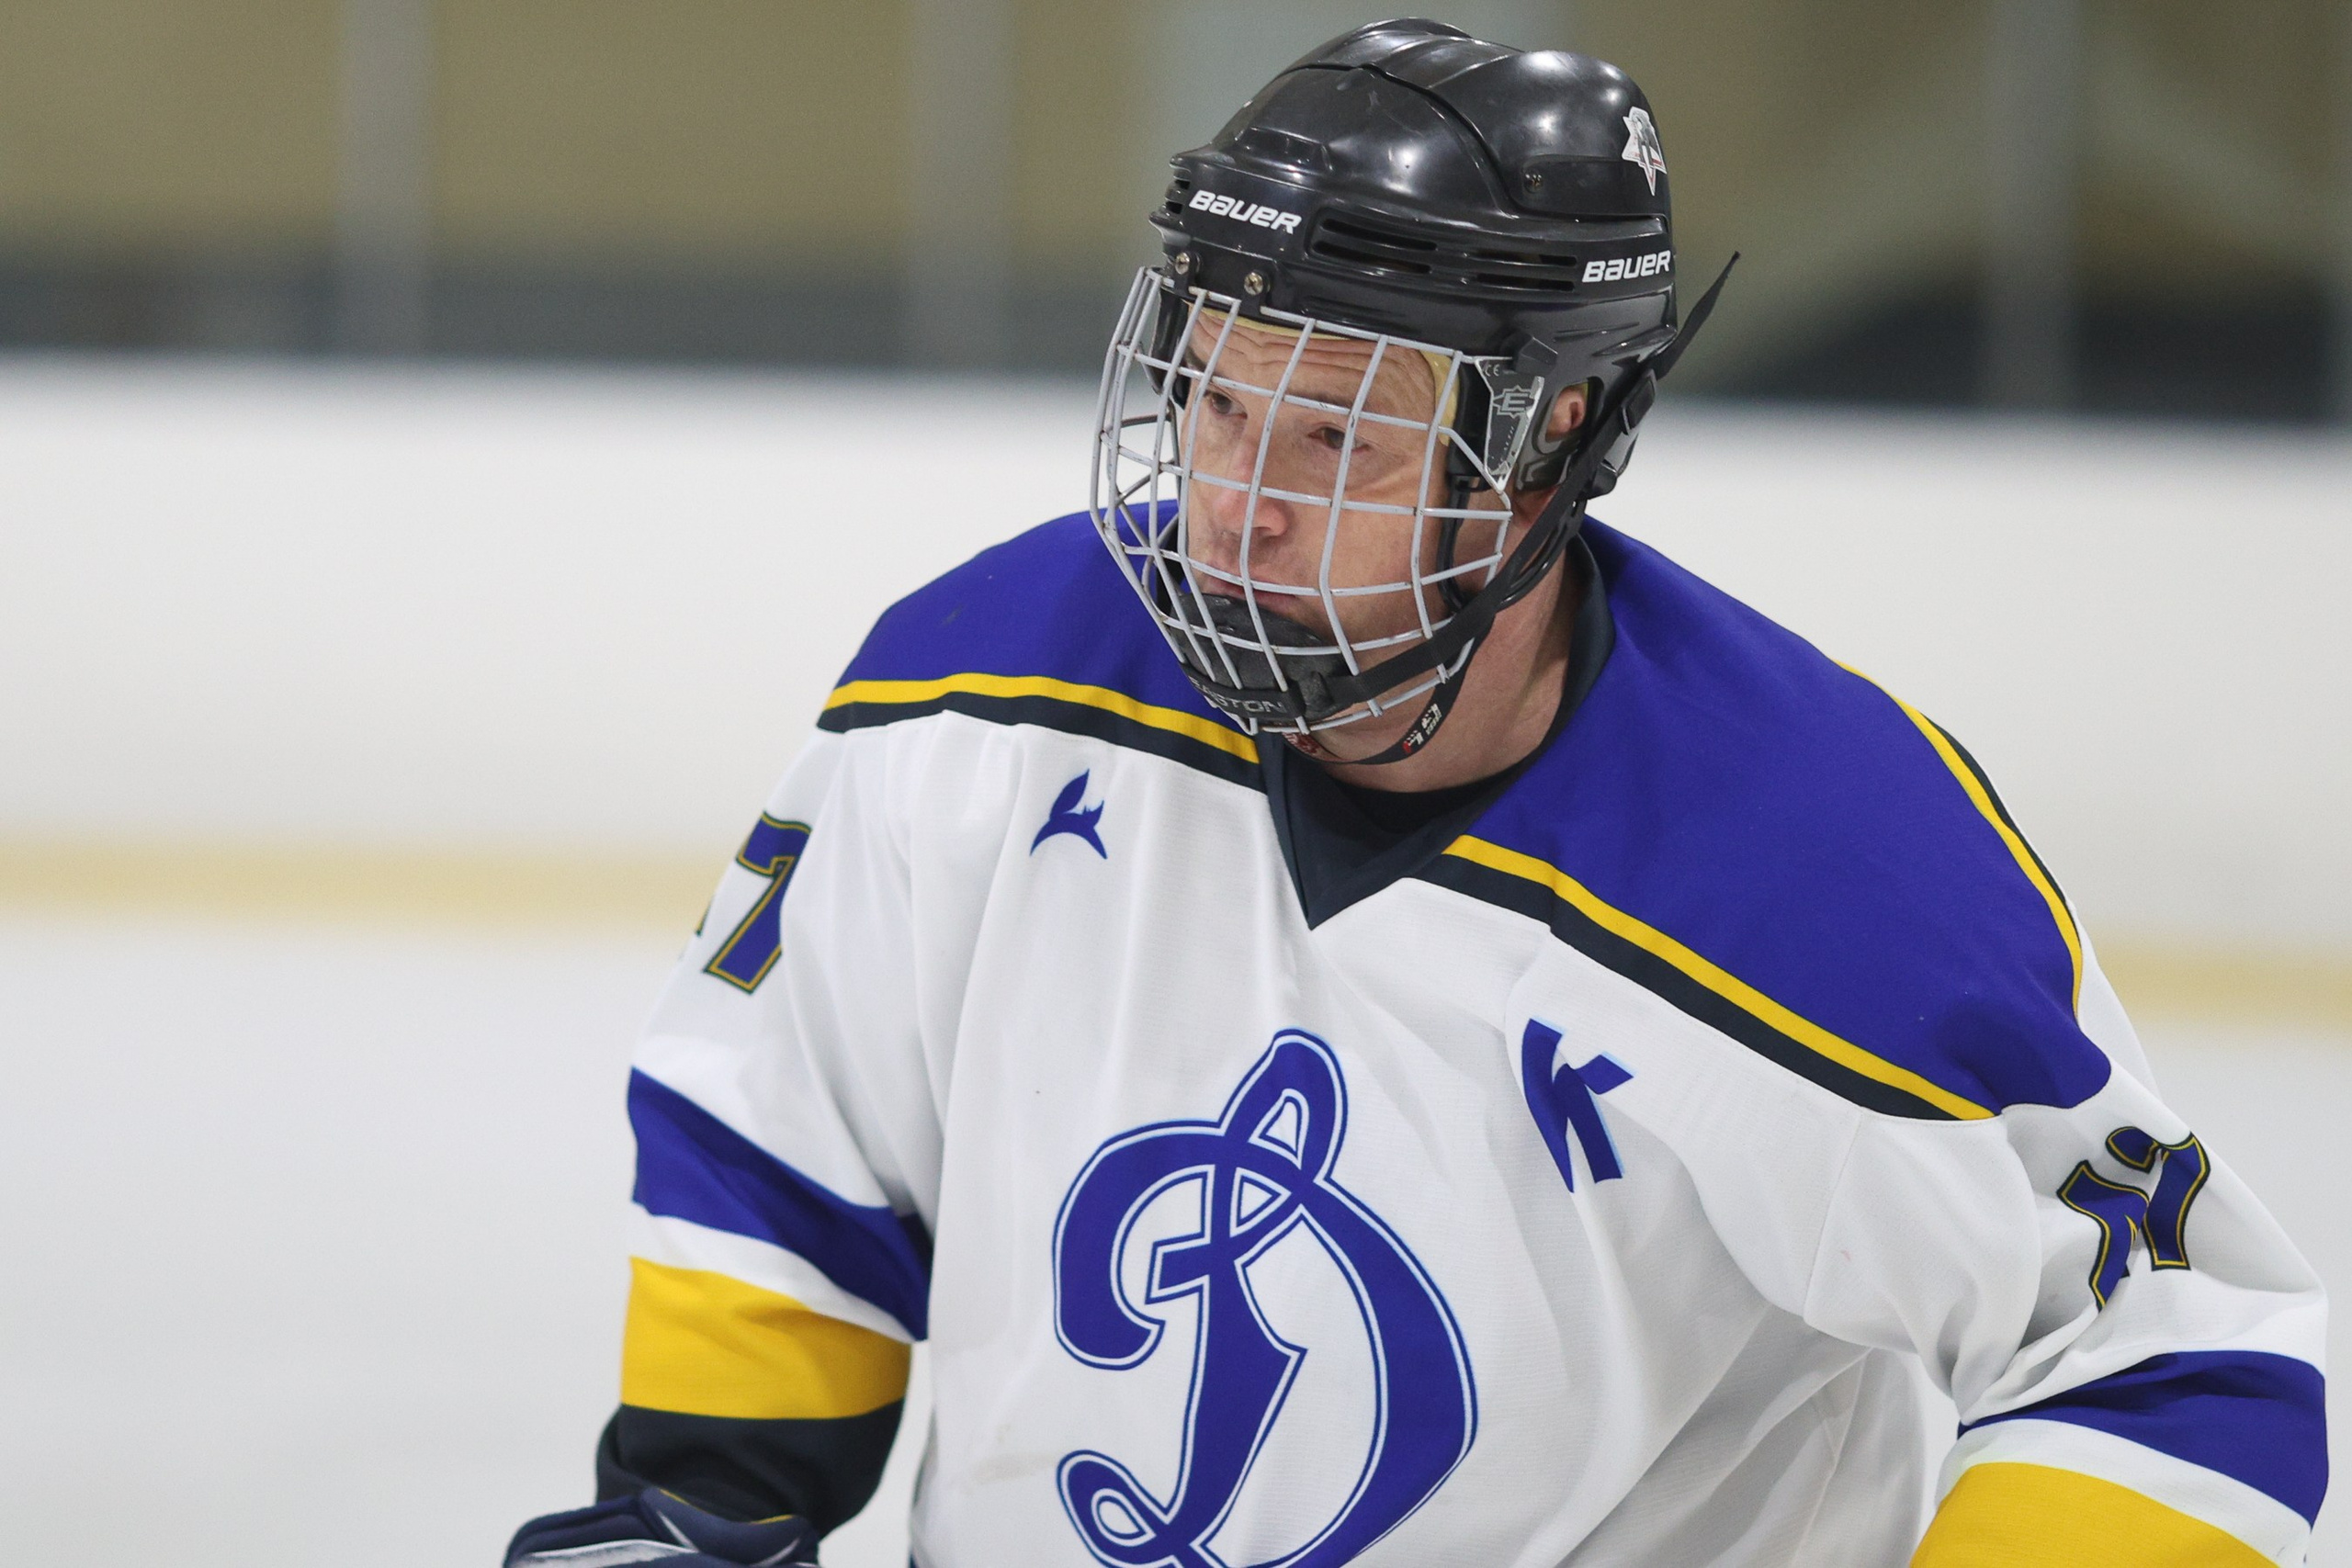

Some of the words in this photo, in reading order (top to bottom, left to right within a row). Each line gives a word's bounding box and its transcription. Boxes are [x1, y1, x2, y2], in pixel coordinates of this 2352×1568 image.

[1189, 189, 1303, 235] BAUER
[1581, 250, 1671, 283] BAUER
[1188, 675, 1287, 714] EASTON
[695, 810, 813, 995] 7
